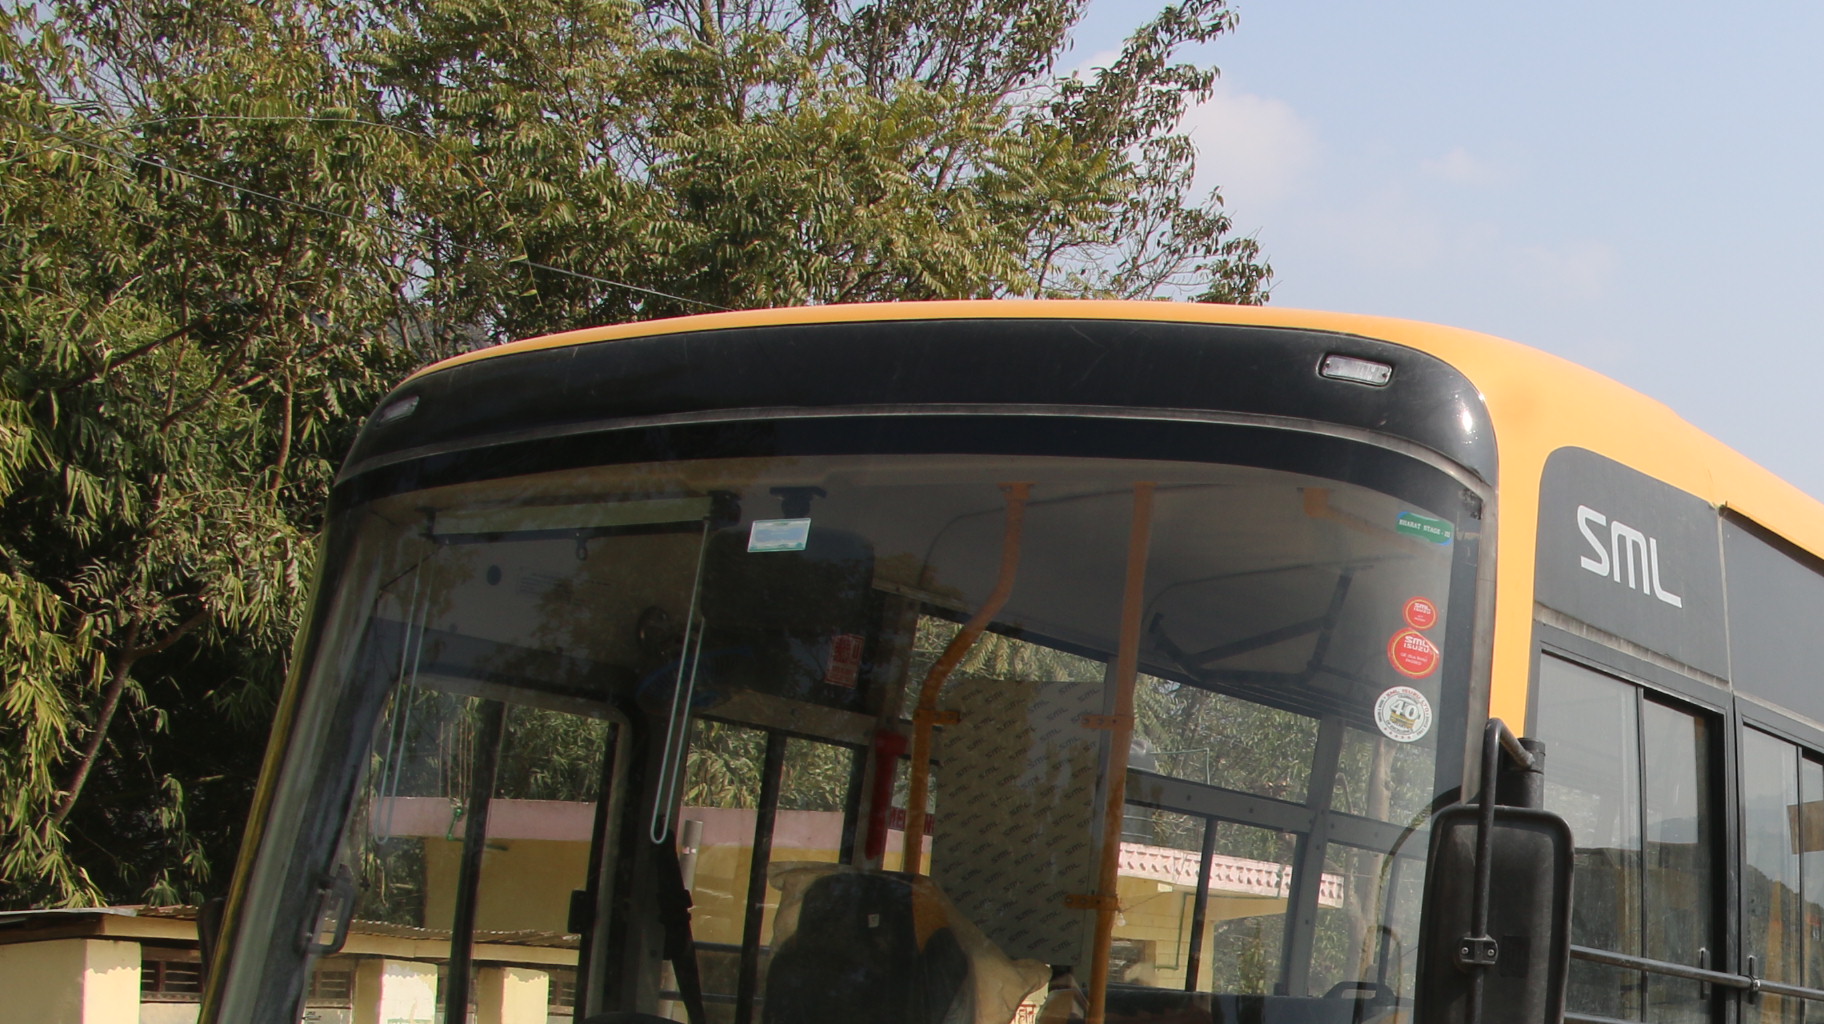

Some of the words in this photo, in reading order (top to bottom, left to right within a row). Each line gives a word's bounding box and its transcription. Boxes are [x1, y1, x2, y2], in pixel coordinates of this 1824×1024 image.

[1398, 518, 1422, 530] BHARAT
[1577, 504, 1682, 608] SML
[1404, 635, 1429, 647] SML
[1403, 642, 1430, 654] ISUZU
[1390, 700, 1419, 720] 40
